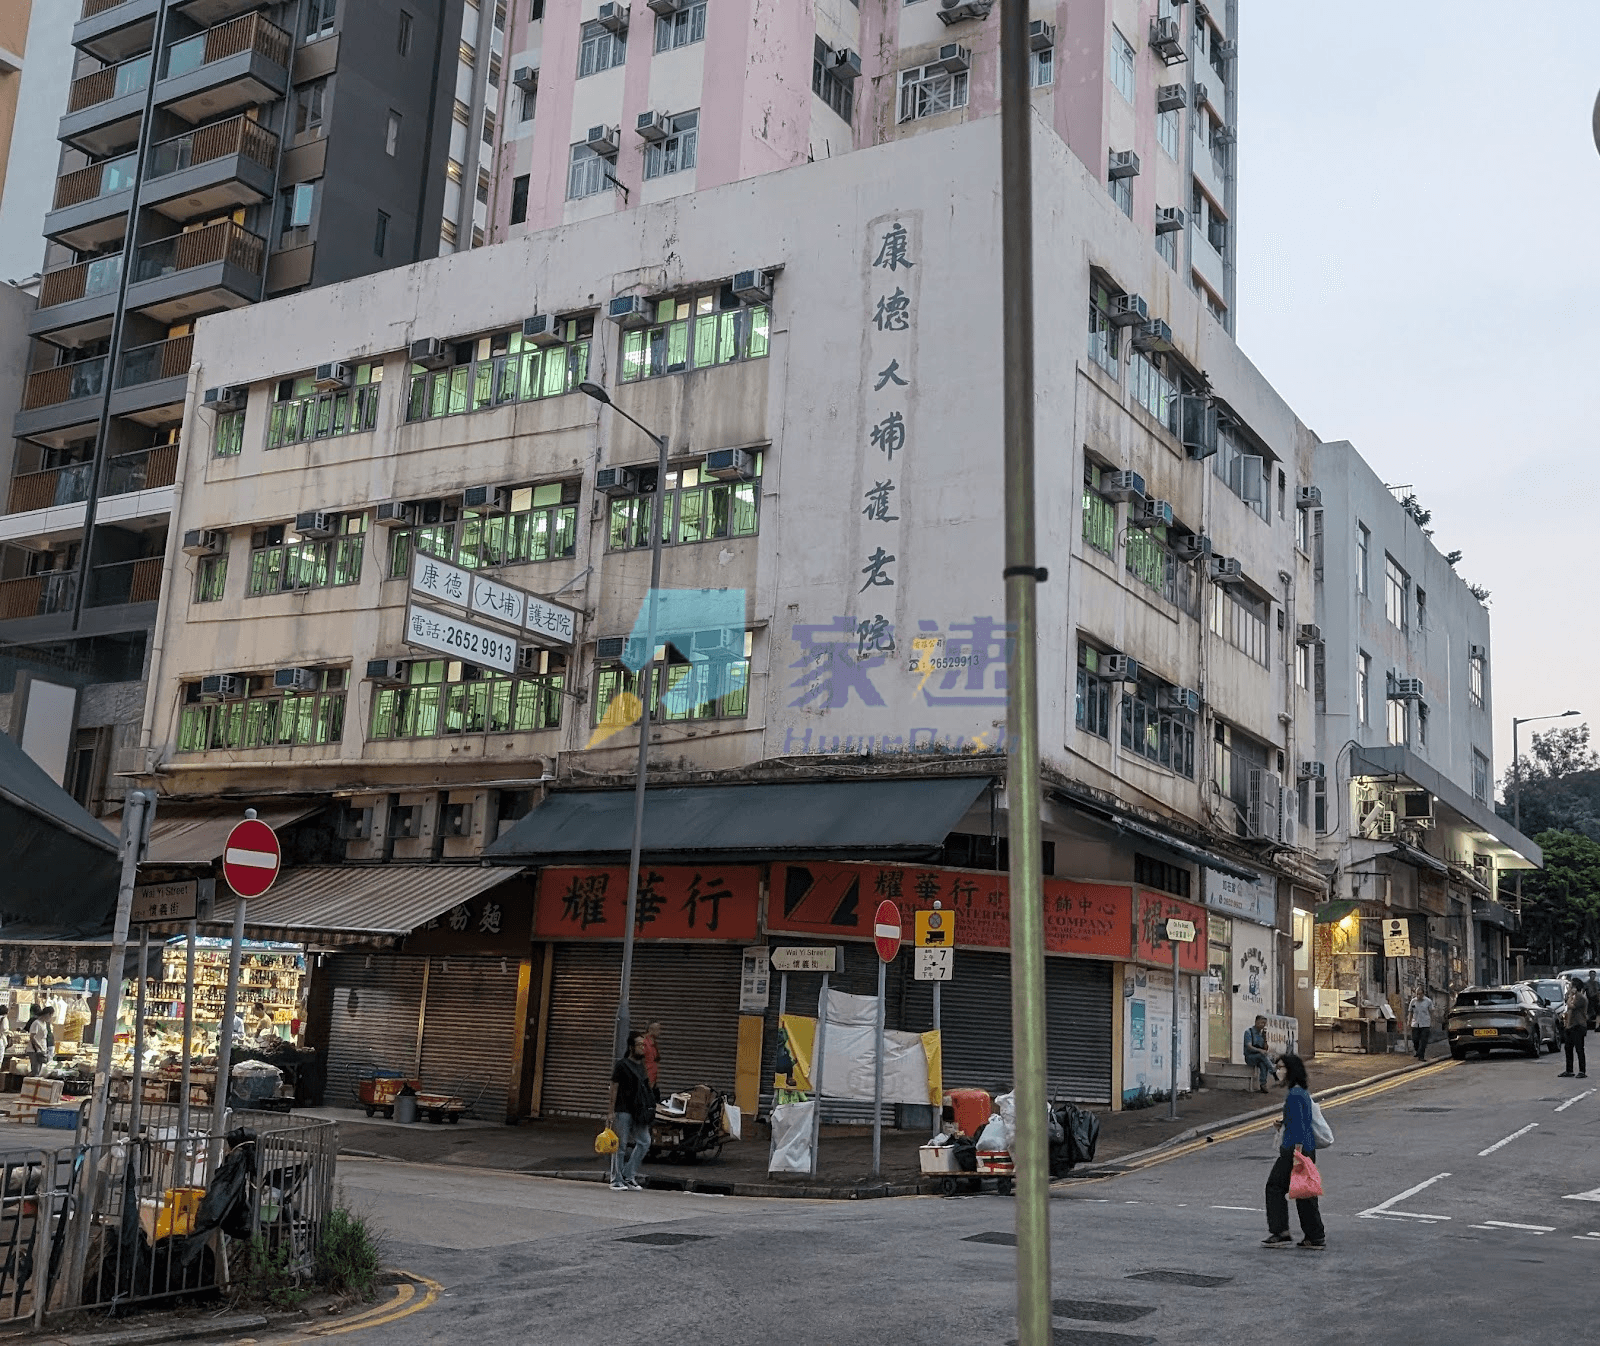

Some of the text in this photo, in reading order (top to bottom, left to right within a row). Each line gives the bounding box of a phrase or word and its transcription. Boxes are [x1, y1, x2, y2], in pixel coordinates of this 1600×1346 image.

[857, 222, 916, 655] 康德大埔護老院
[482, 637, 512, 663] 9913
[142, 888, 155, 898] Wai
[165, 885, 188, 896] Street
[874, 869, 979, 909] 耀華行
[560, 872, 733, 932] 耀華行
[1047, 915, 1114, 930] COMPANY
[940, 950, 947, 961] 7
[922, 971, 933, 979] 下午
[939, 967, 946, 979] 7
